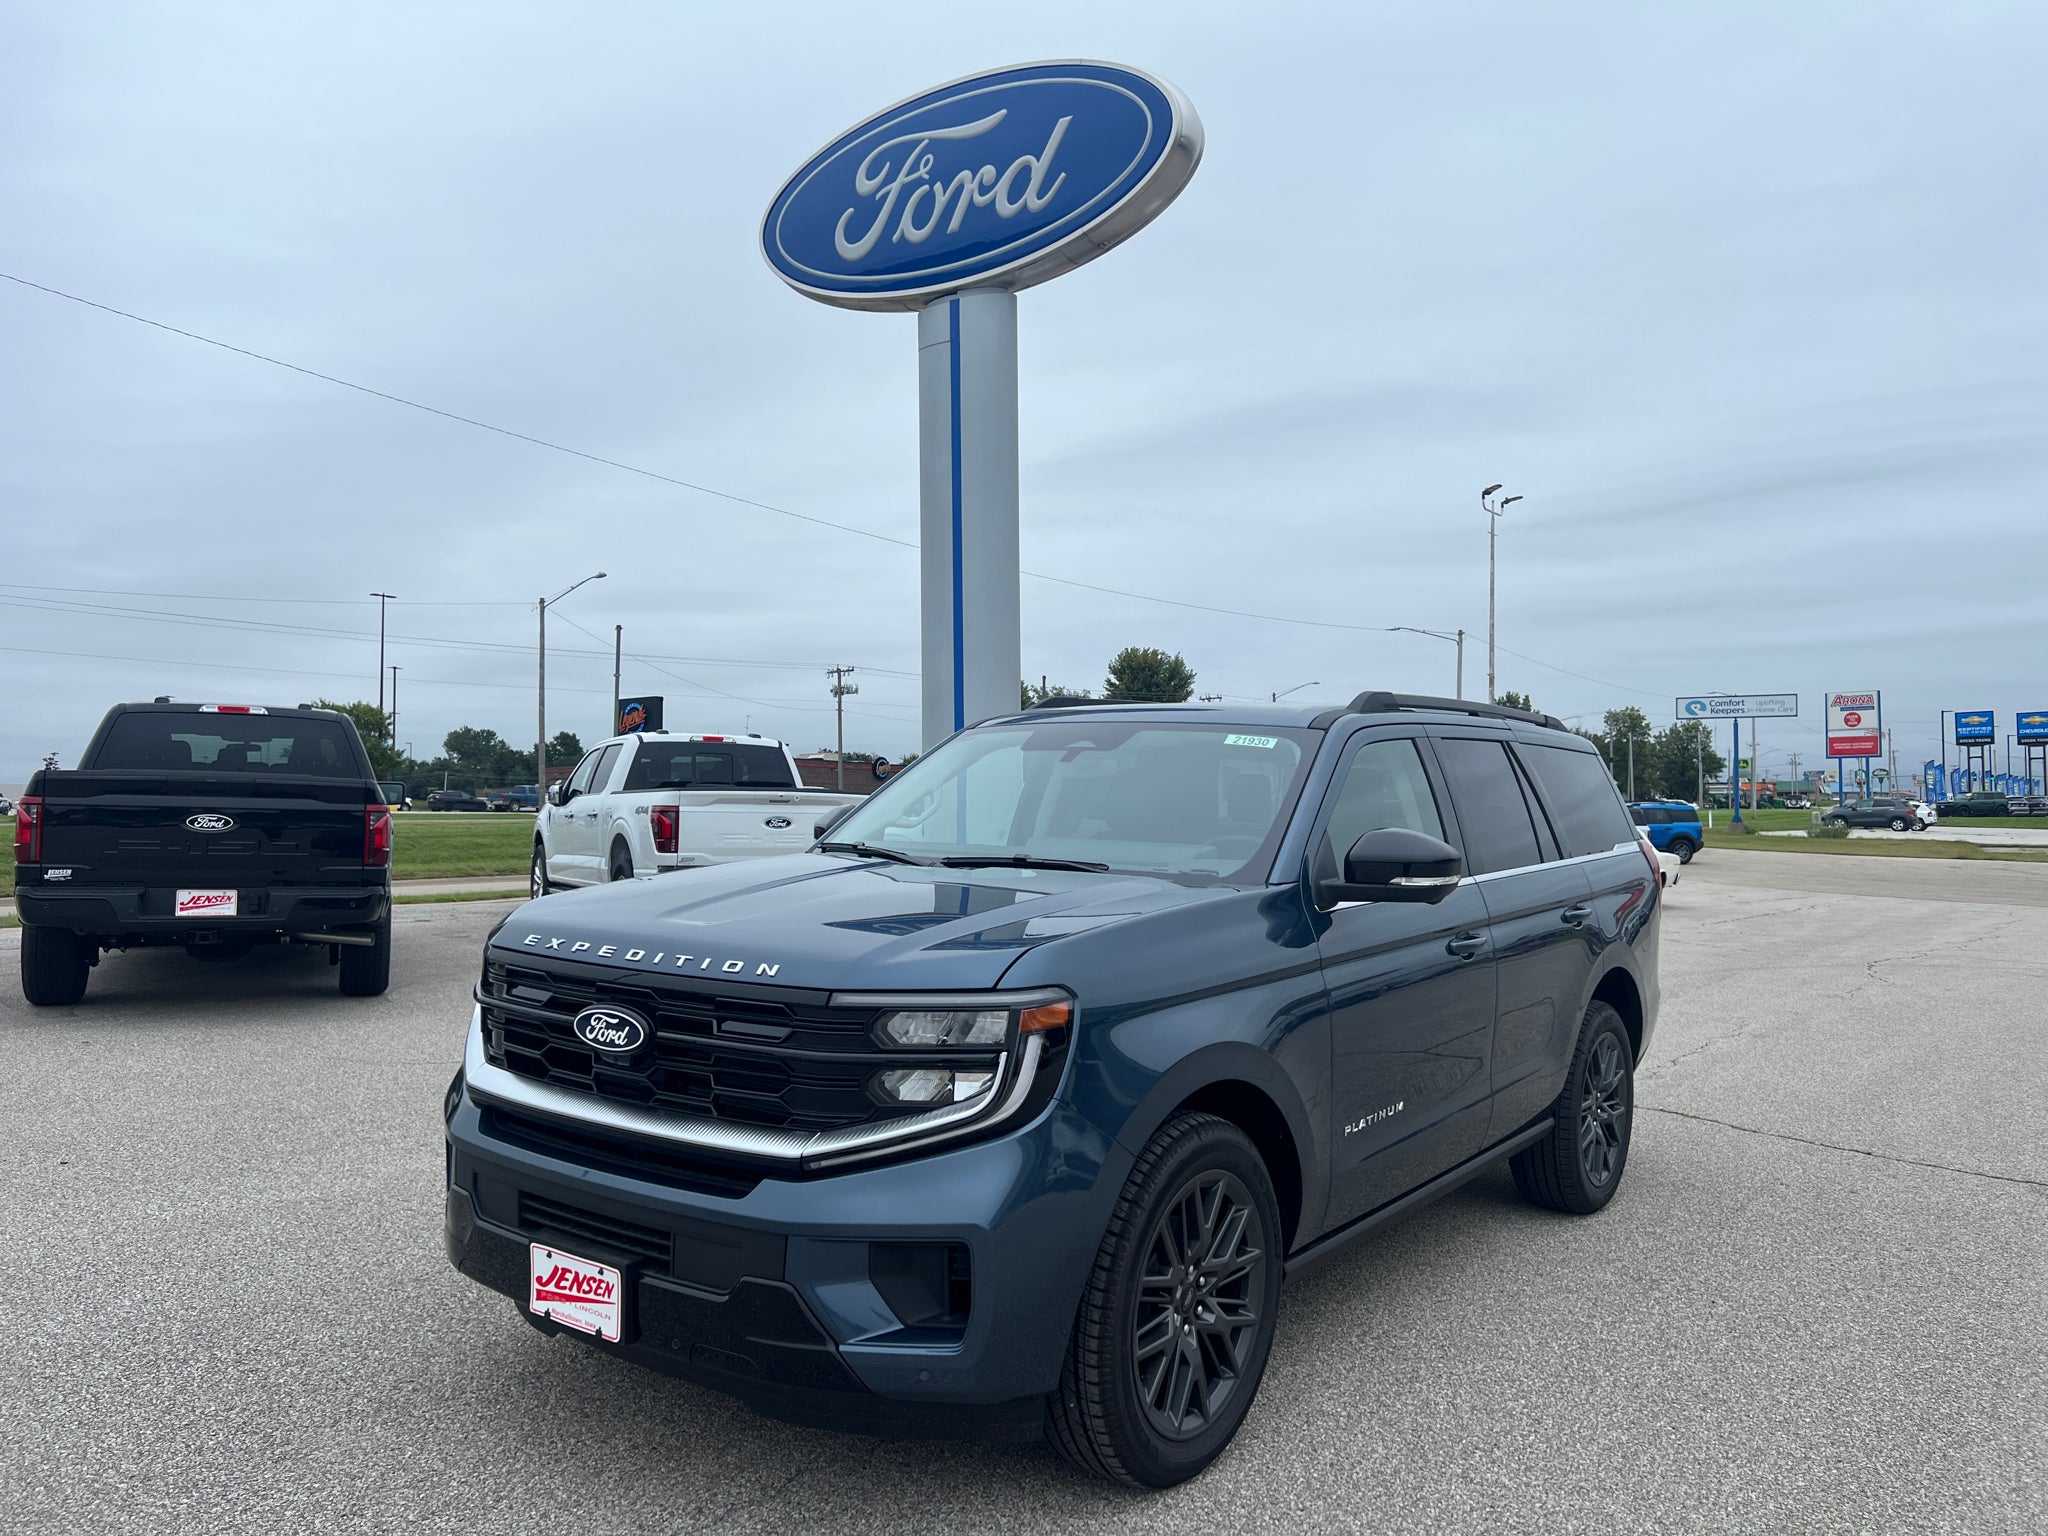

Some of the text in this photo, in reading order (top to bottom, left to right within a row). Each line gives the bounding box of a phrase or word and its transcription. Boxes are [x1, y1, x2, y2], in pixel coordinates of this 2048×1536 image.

[833, 108, 1074, 262] Ford
[1709, 699, 1786, 707] Comfort Uplifting
[1831, 695, 1874, 707] ARONA
[1710, 707, 1745, 715] Keepers
[1233, 736, 1270, 747] 21930
[194, 816, 226, 829] Ford
[768, 819, 788, 828] Ford
[44, 868, 73, 878] JENSEN
[179, 895, 234, 906] JENSEN
[523, 934, 781, 977] EXPEDITION
[585, 1013, 629, 1046] Ford
[1344, 1101, 1404, 1137] PLATINUM
[535, 1264, 615, 1300] JENSEN
[574, 1303, 611, 1321] LINCOLN
